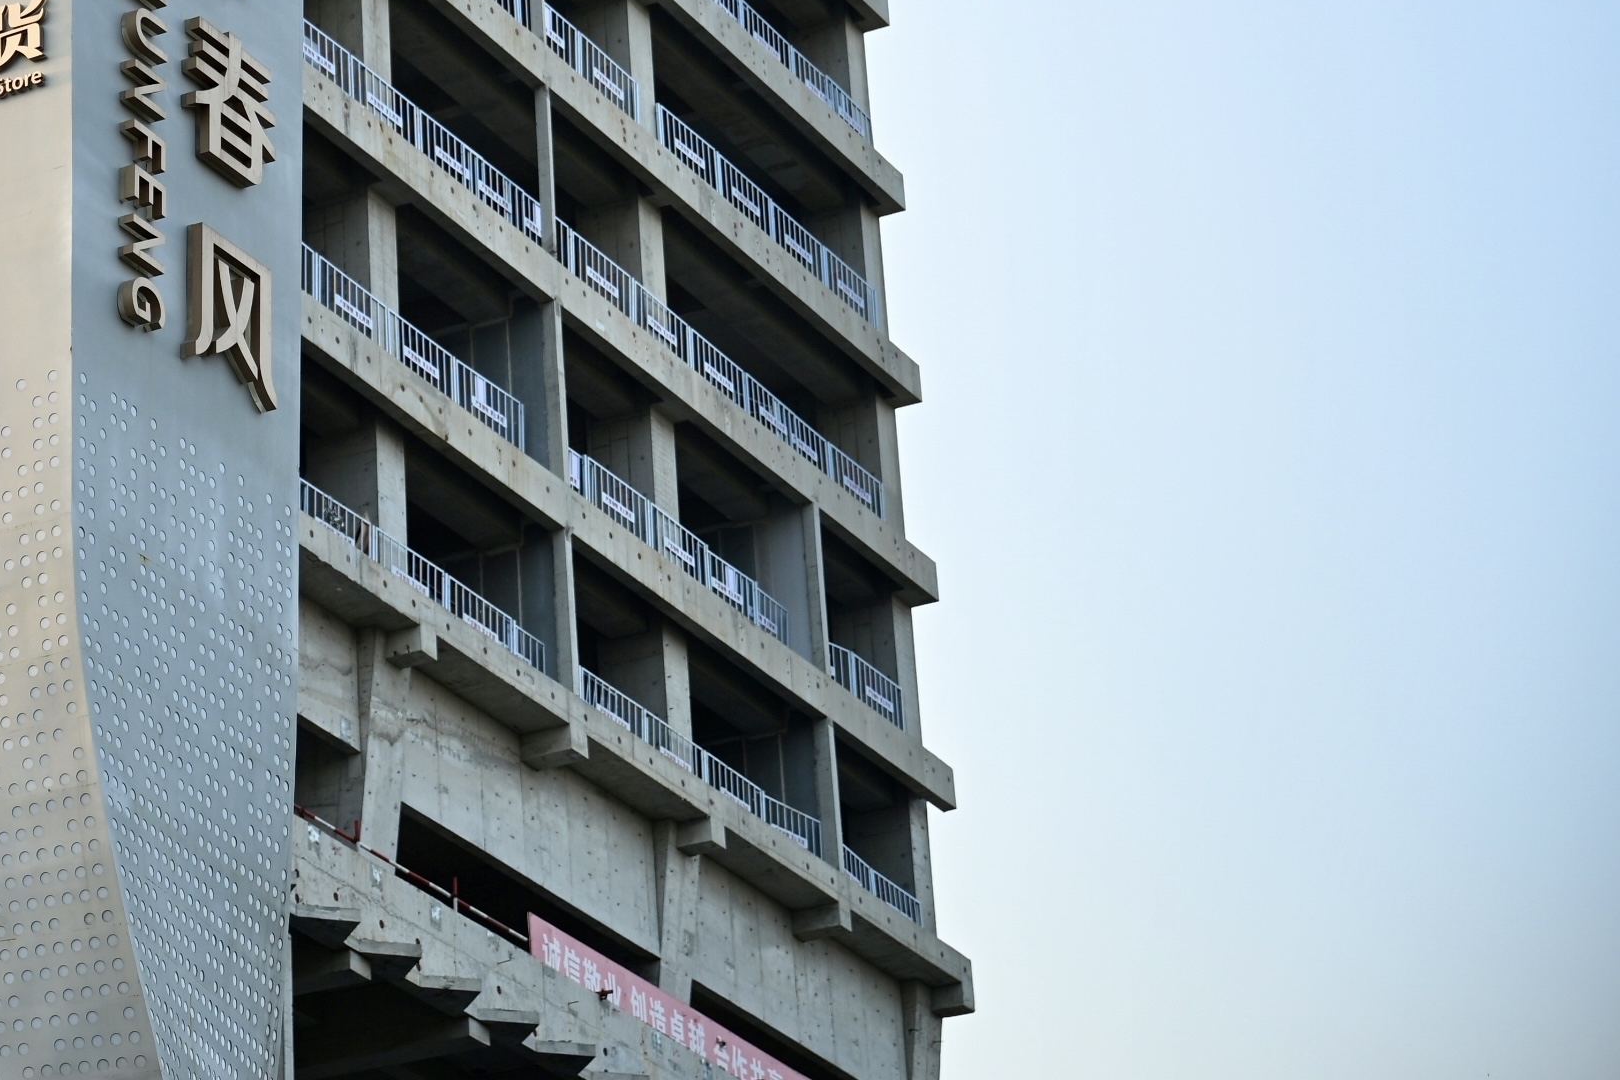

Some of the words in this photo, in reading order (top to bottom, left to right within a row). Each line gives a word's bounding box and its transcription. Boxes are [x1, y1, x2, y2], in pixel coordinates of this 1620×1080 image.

[542, 933, 622, 1006] 诚信敬业
[630, 985, 706, 1058] 创造卓越
